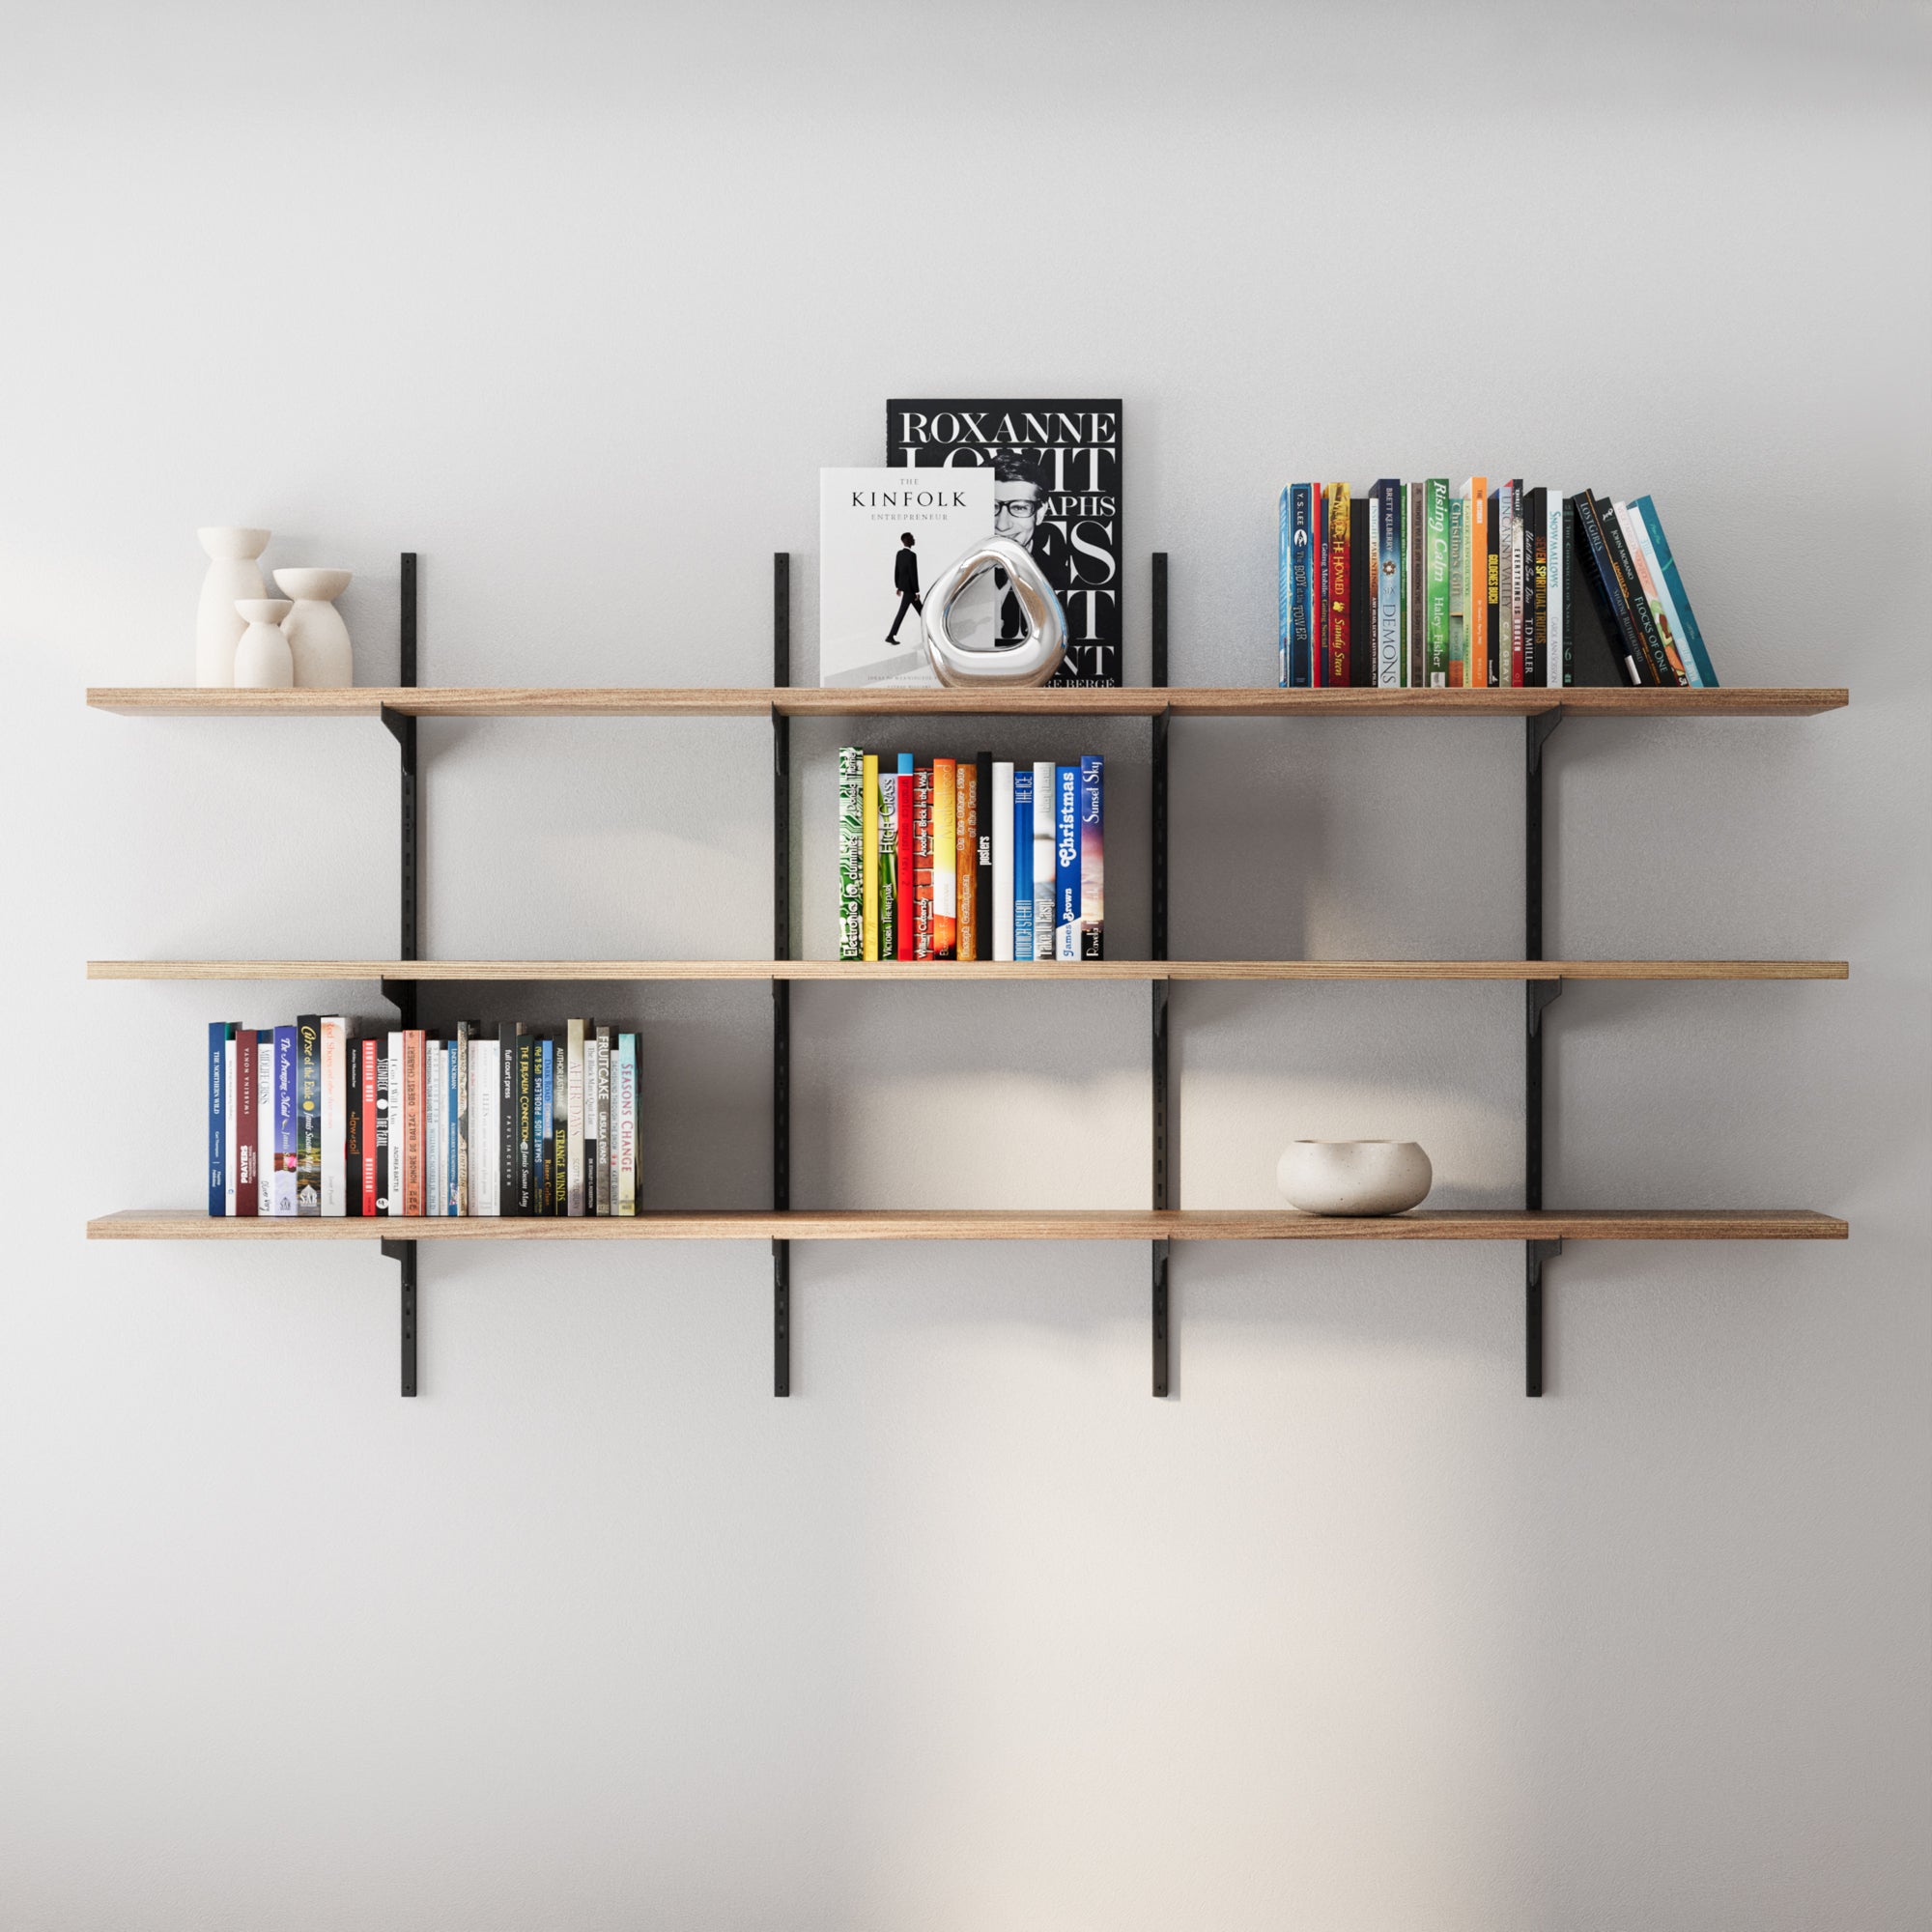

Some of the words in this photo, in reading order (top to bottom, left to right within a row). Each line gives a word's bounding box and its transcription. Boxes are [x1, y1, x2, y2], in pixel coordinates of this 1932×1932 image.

[897, 412, 1115, 444] ROXANNE
[852, 492, 967, 507] KINFOLK
[1429, 481, 1447, 531] Rising
[1451, 502, 1463, 566] Christina's
[1502, 496, 1512, 562] UNCANNY
[1332, 541, 1345, 553] HE
[1435, 537, 1446, 582] Calm
[1536, 536, 1546, 564] SEVEN
[1549, 511, 1560, 587] SNOWMALLOWS
[1611, 529, 1623, 549] JOHN
[1618, 549, 1634, 582] MORANO
[1294, 565, 1307, 587] BODY
[1332, 556, 1345, 594] HOWLED
[1489, 554, 1498, 585] GOLDENES
[1489, 587, 1498, 604] BUCH
[1502, 567, 1512, 610] VALLEY
[1536, 566, 1546, 610] SPIRITUAL
[1293, 605, 1307, 640] TOWER
[1432, 596, 1444, 628] Haley
[1536, 611, 1546, 643] TRUTHS
[1613, 588, 1627, 616] SHAYNE
[1623, 616, 1643, 663] RUTHERFORD
[1333, 618, 1345, 648] Sandy
[1380, 604, 1398, 683] DEMONS
[1634, 596, 1653, 633] FLOCKS
[1648, 632, 1658, 645] OF
[1654, 644, 1667, 671] ONE
[1334, 651, 1345, 676] Steen
[1434, 634, 1444, 668] Fisher
[1015, 777, 1032, 788] ICE
[1083, 761, 1102, 784] Sky
[879, 779, 895, 816] GRASS
[901, 780, 910, 818] graphics
[956, 792, 965, 817] Other
[1015, 790, 1032, 804] THE
[1083, 787, 1099, 824] Sunset
[956, 821, 965, 836] the
[1059, 773, 1076, 867] Christmas
[879, 821, 895, 854] HIGH
[901, 822, 910, 851] annual
[978, 836, 992, 866] posters
[843, 836, 858, 879] dummies
[901, 856, 910, 875] rev.
[1036, 898, 1055, 923] Easy!
[1063, 889, 1074, 922] Brown
[843, 902, 858, 957] Electronics
[1064, 924, 1075, 957] James
[1036, 934, 1052, 957] Take
[281, 1038, 291, 1052] The
[301, 1026, 316, 1056] Curse
[260, 1050, 270, 1081] MIDLIFE
[279, 1054, 291, 1091] Avenging
[304, 1057, 315, 1065] of
[304, 1067, 315, 1079] the
[599, 1036, 609, 1099] FRUITCAKE
[259, 1082, 270, 1104] CRISIS
[304, 1081, 315, 1099] Exile
[569, 1062, 582, 1098] AFTER
[621, 1064, 634, 1115] SEASONS
[281, 1092, 291, 1117] Maid
[304, 1112, 315, 1131] Janis
[350, 1117, 359, 1134] law
[377, 1117, 388, 1127] THE
[569, 1105, 582, 1136] DAYS
[304, 1133, 315, 1153] Susan
[350, 1139, 359, 1154] soil
[377, 1130, 388, 1147] PEARL
[621, 1121, 634, 1173] CHANGE
[303, 1155, 314, 1173] May
[261, 1180, 270, 1197] Oliver
[520, 1191, 528, 1208] May
